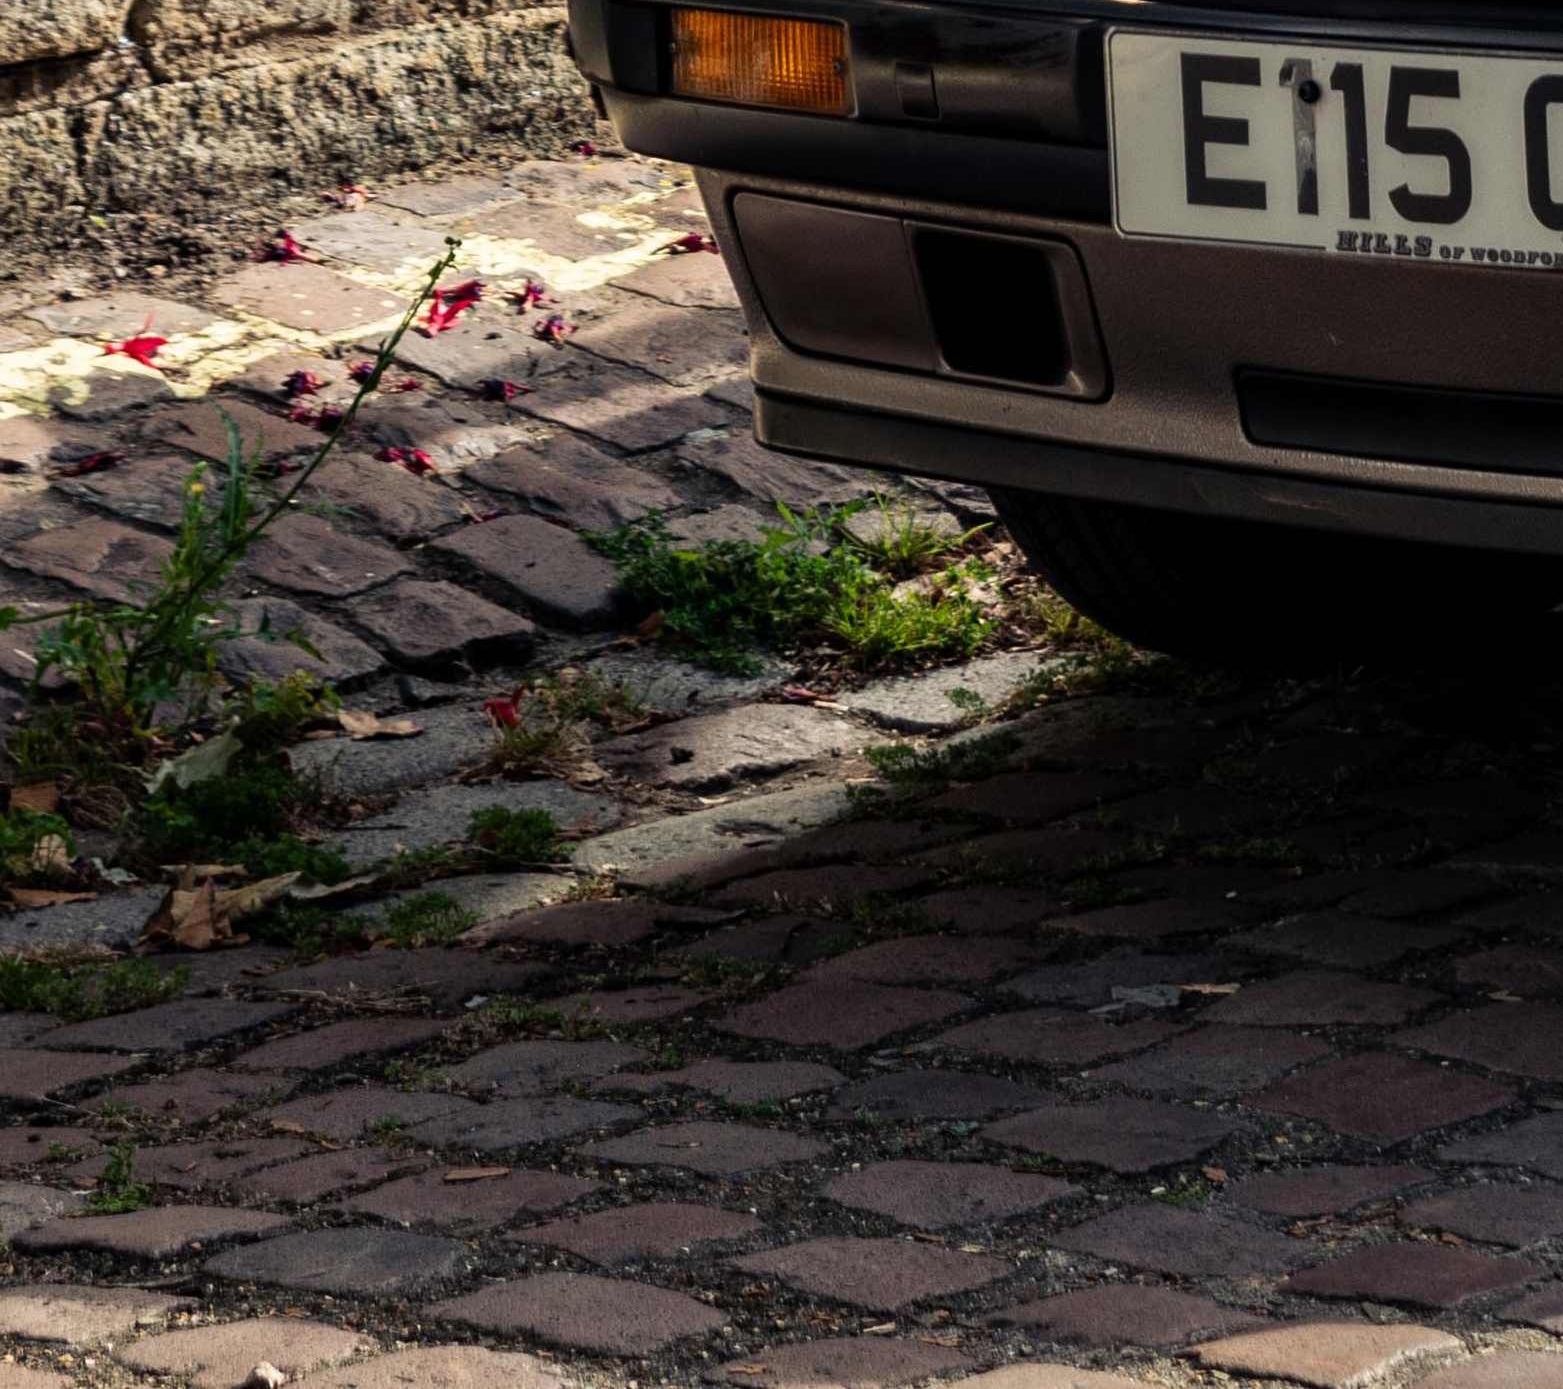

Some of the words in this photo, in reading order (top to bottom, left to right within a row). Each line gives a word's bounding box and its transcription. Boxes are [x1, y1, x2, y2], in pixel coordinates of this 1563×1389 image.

[1180, 50, 1474, 227] E115
[1335, 230, 1432, 258] HILLS
[1439, 245, 1465, 261] OF
